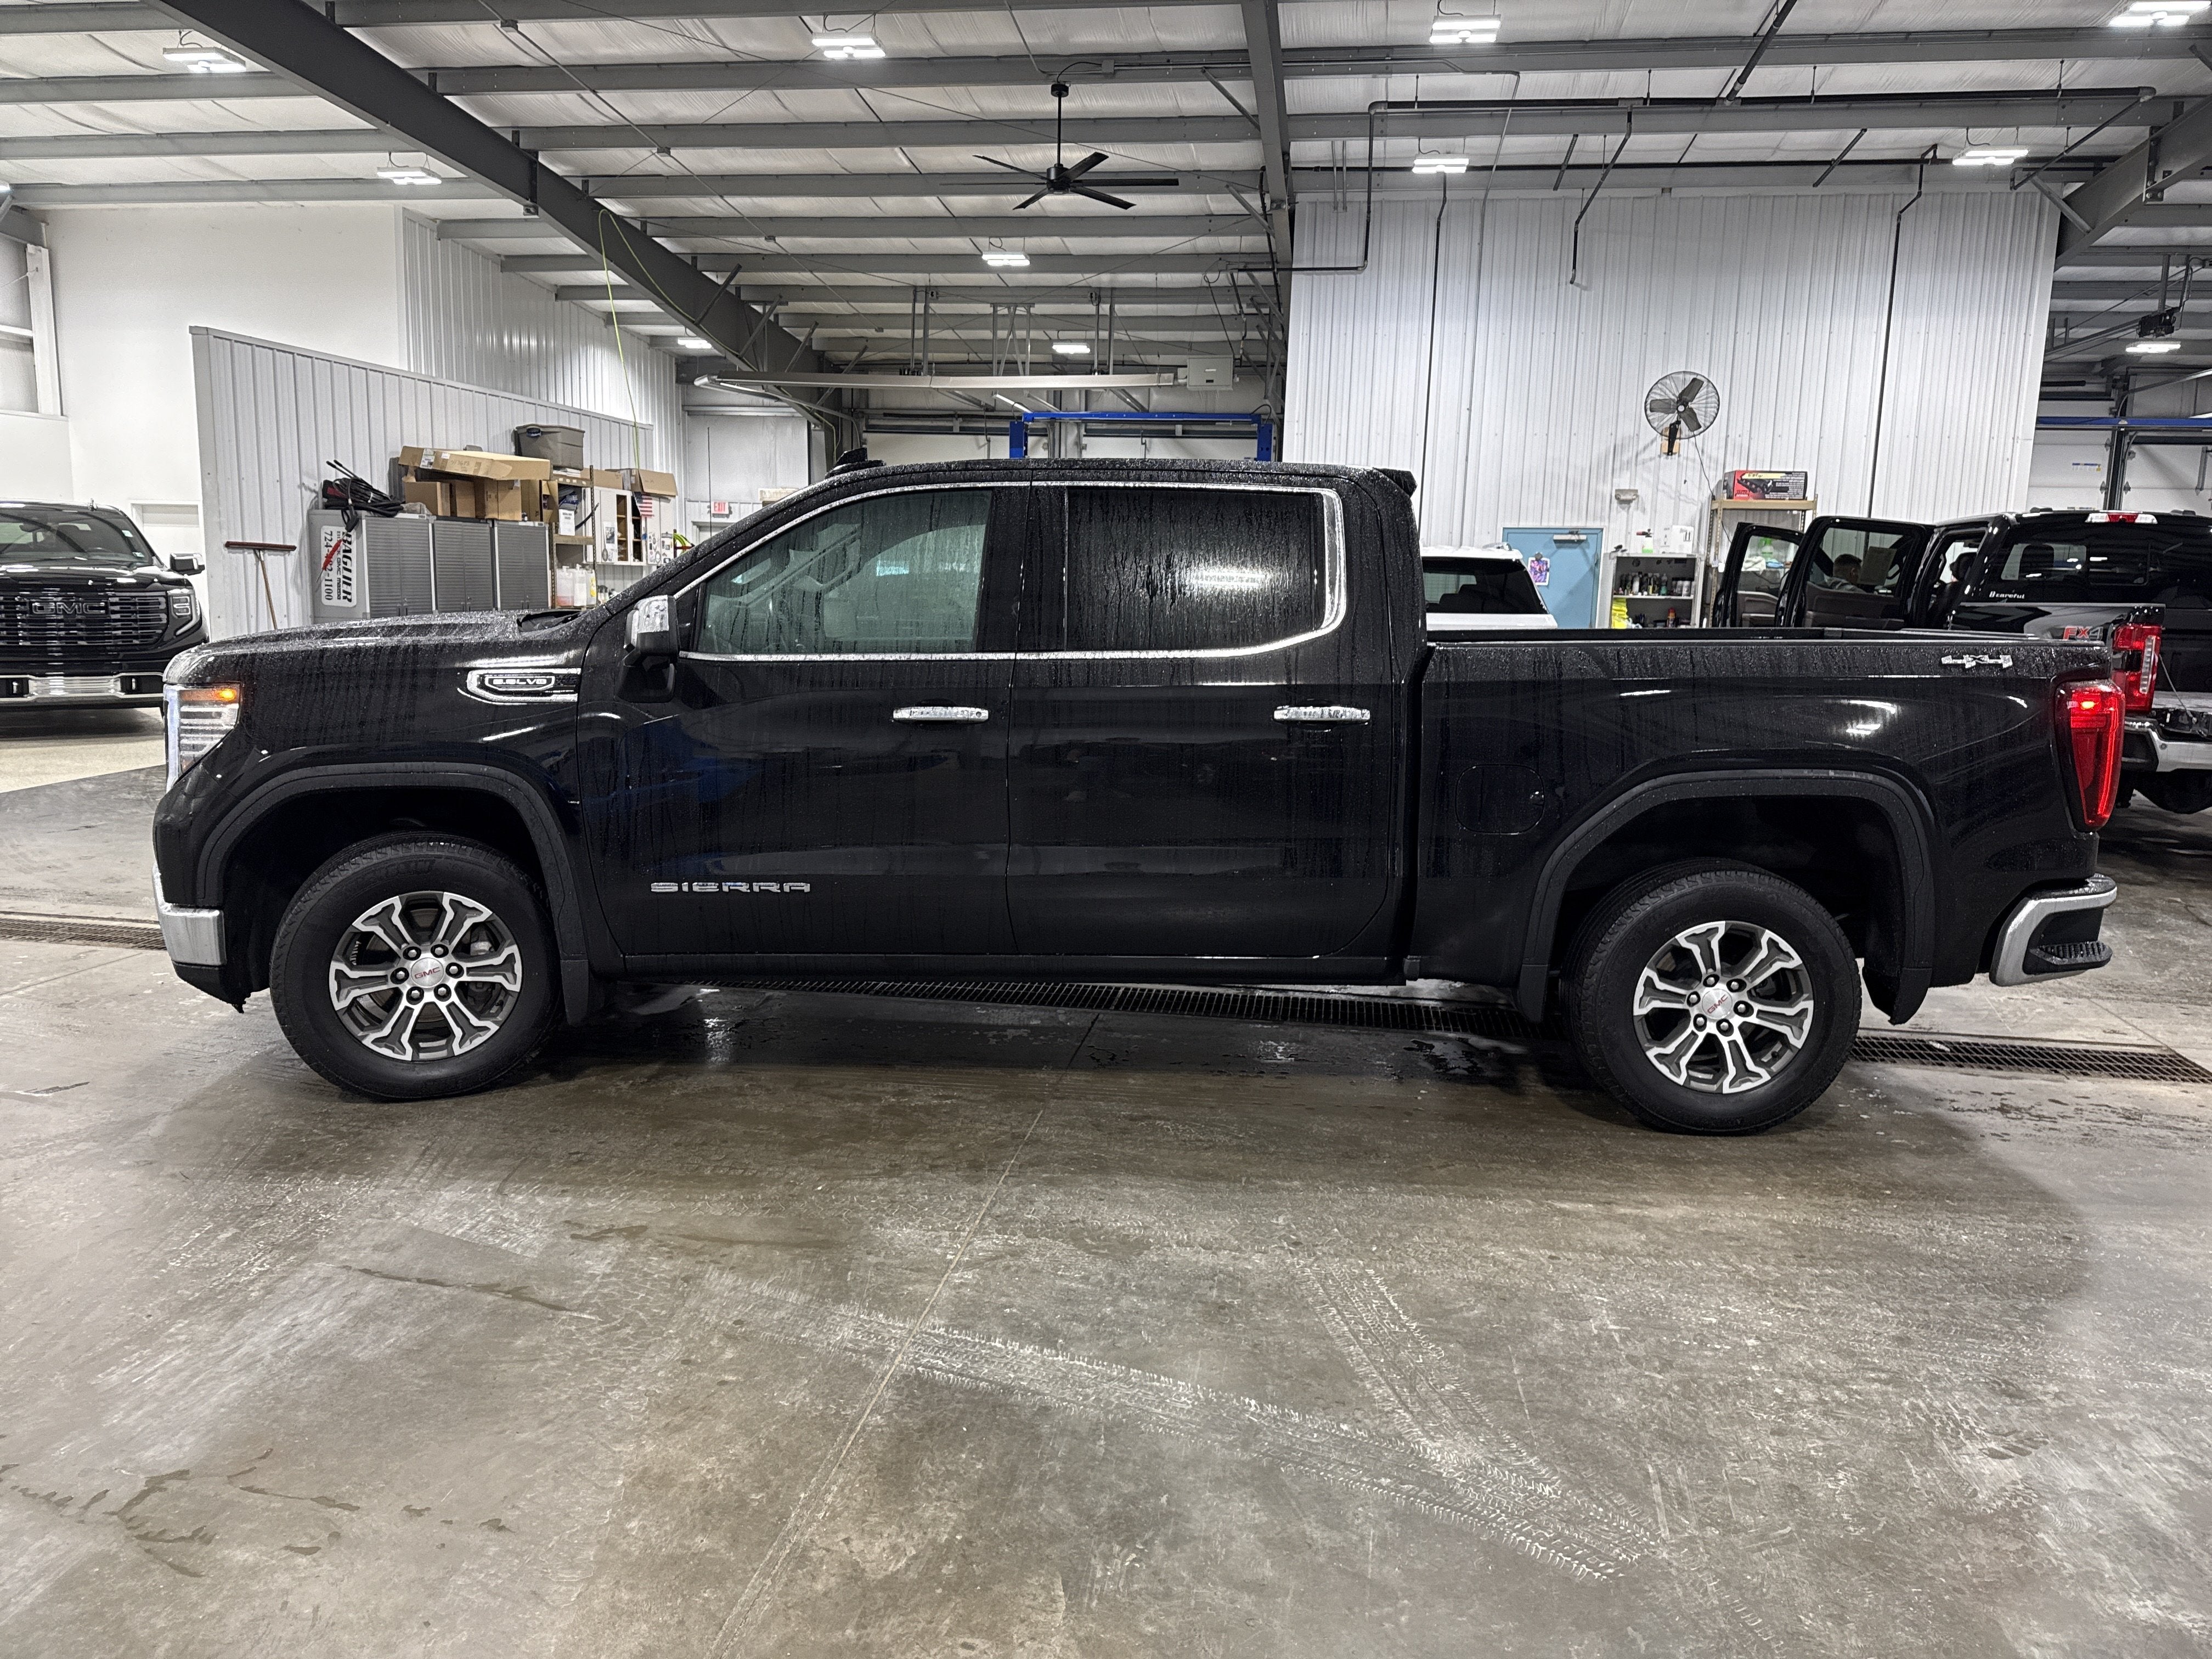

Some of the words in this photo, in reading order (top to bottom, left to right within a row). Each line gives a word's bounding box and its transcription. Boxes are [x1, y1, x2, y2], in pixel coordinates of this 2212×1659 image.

[714, 501, 726, 512] EXIT
[342, 532, 352, 602] BAGLIER
[32, 602, 105, 614] GMC
[2063, 625, 2103, 641] FX4
[651, 882, 810, 893] SIERRA
[414, 966, 441, 979] GMC
[1707, 994, 1728, 1014] GMC
